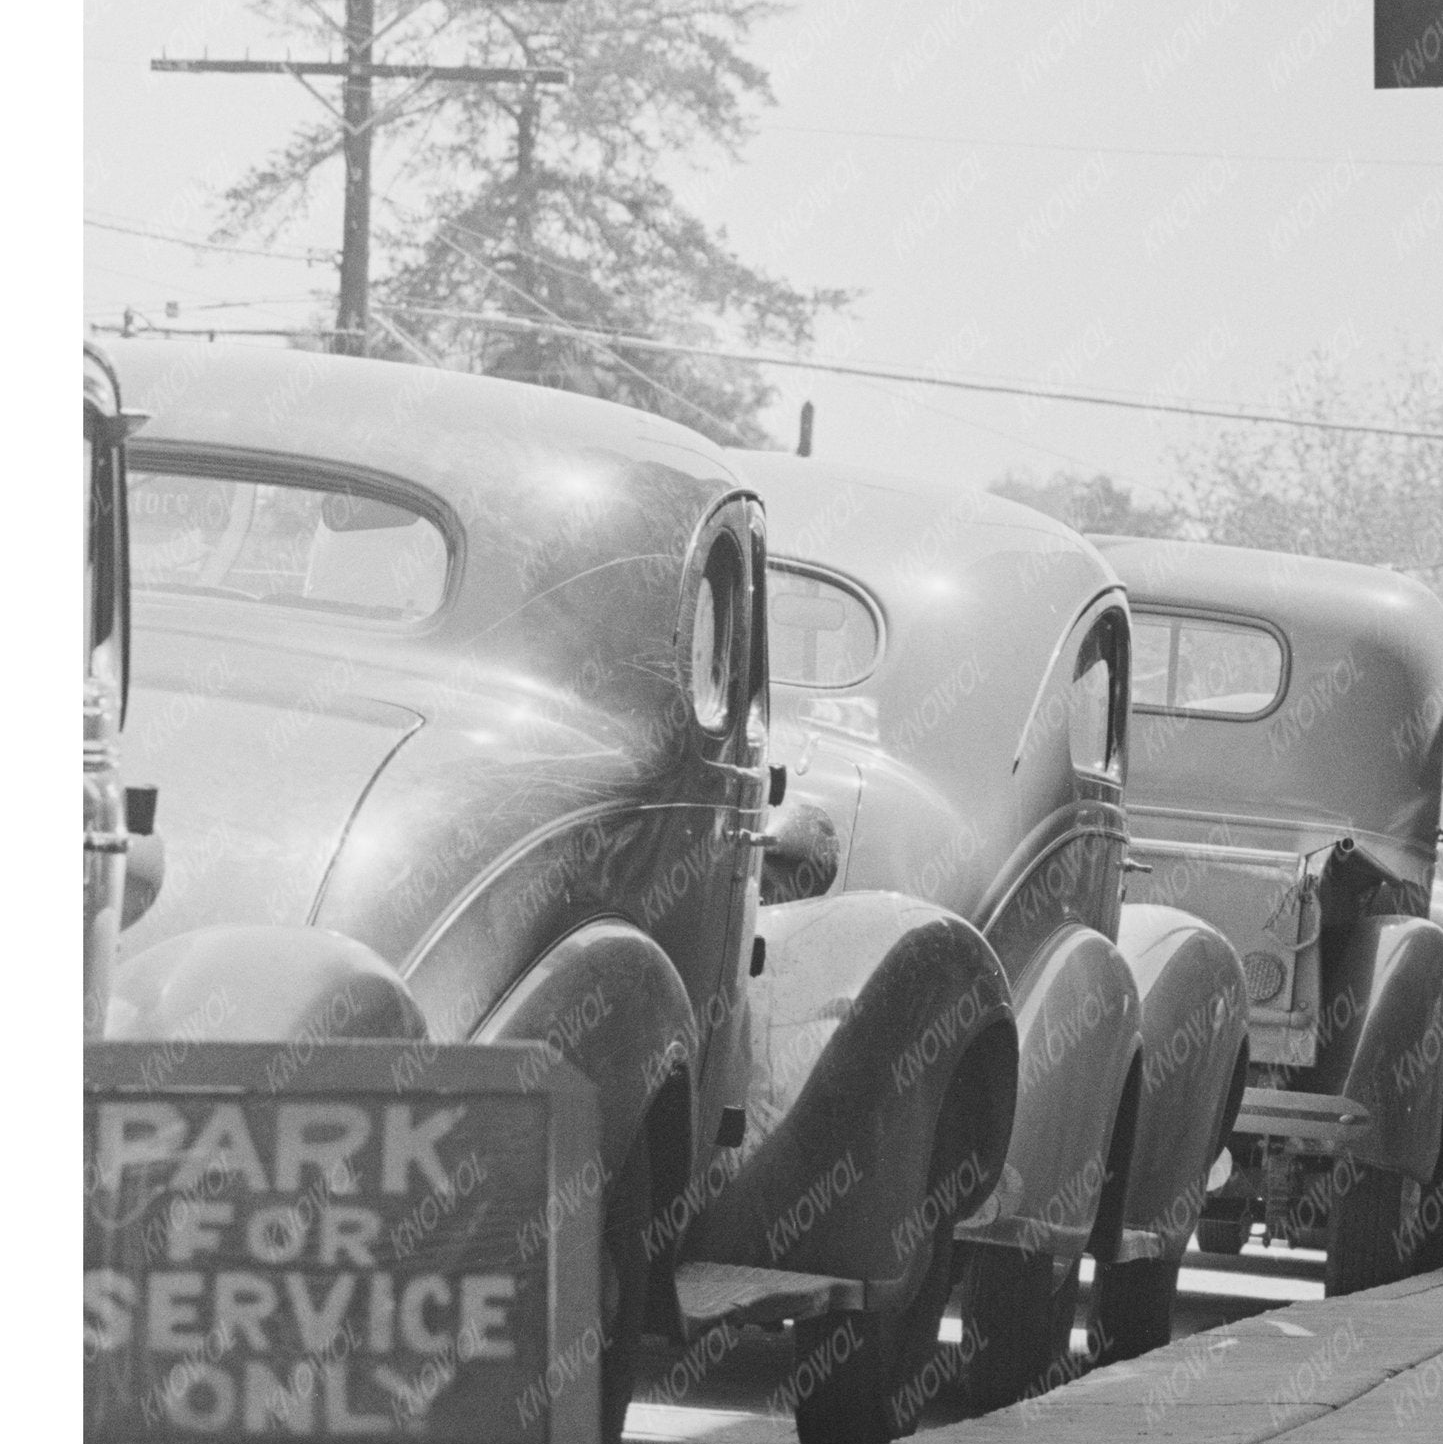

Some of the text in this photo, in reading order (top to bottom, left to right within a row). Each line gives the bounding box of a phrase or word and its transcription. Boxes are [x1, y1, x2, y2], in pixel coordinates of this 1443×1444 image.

[98, 1102, 469, 1195] PARK
[168, 1201, 382, 1267] FOR
[83, 1269, 517, 1359] SERVICE
[165, 1362, 457, 1434] ONLY
